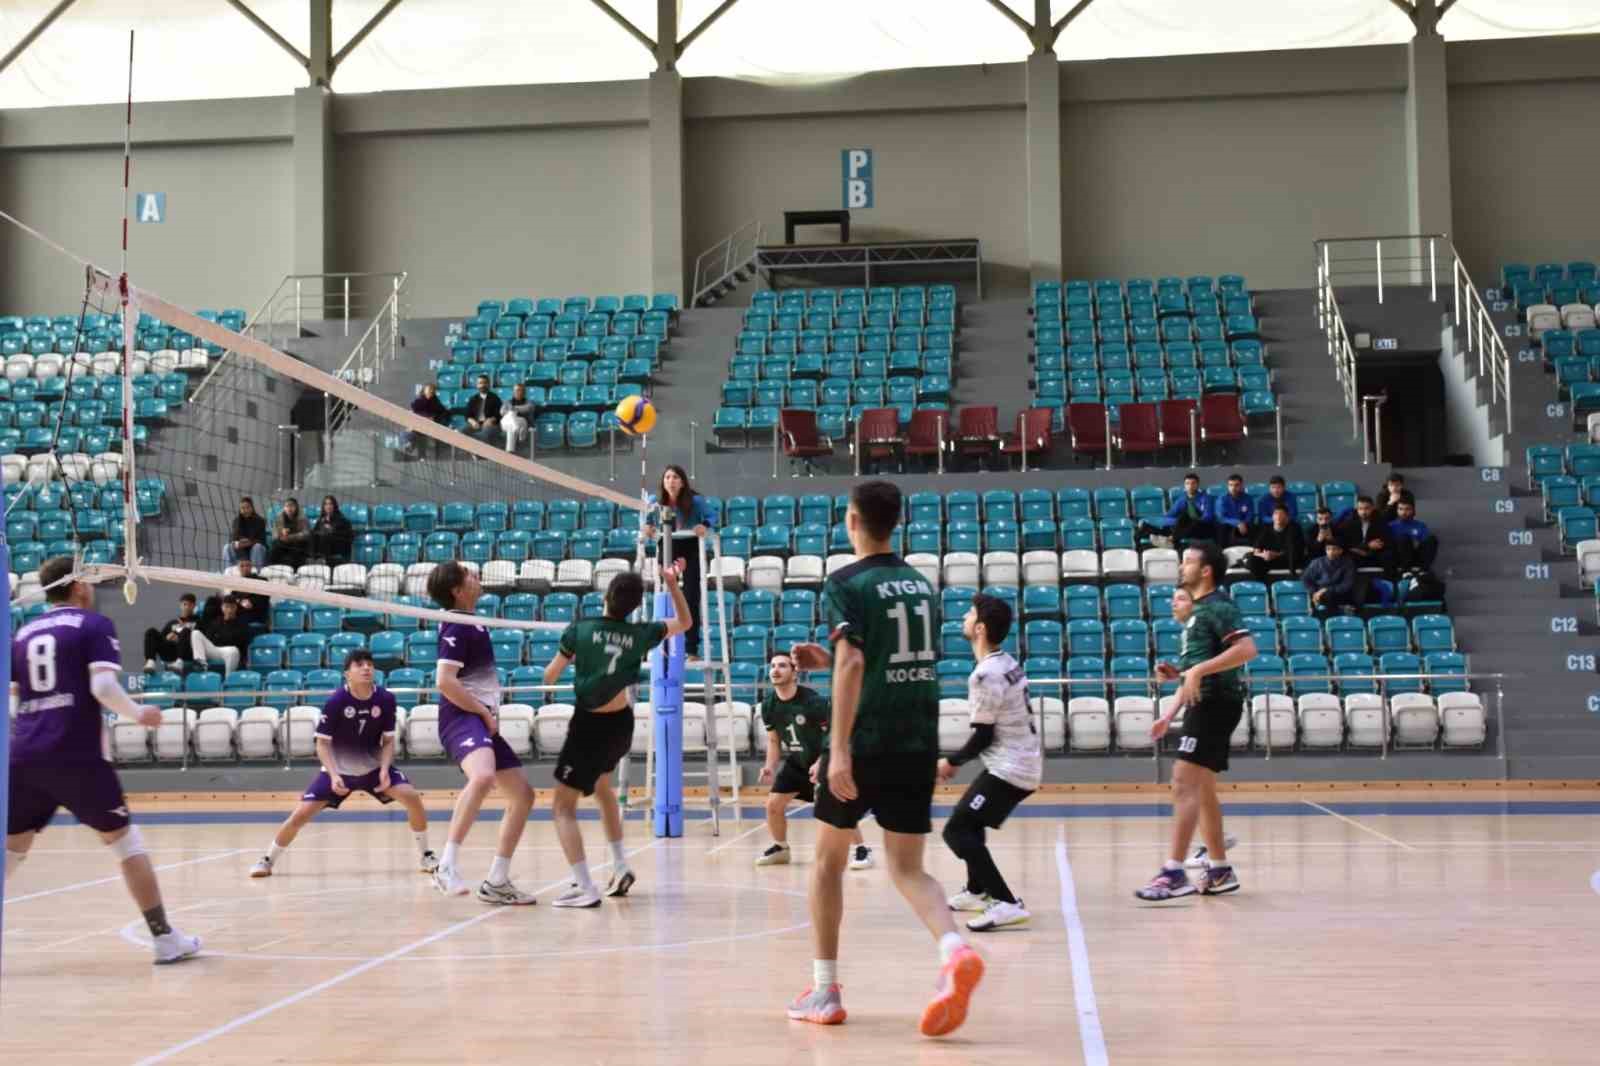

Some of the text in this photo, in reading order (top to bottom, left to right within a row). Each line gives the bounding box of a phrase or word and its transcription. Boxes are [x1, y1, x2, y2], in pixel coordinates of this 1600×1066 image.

[849, 150, 867, 178] P
[848, 180, 867, 208] B
[141, 194, 160, 222] A
[1518, 350, 1535, 362] C4
[1546, 404, 1564, 417] C6
[1481, 468, 1500, 482] C8
[1495, 500, 1513, 513] C9
[1508, 531, 1533, 545] C10
[1525, 564, 1549, 579] C11
[886, 599, 936, 663] 11
[1551, 617, 1577, 632] C12
[27, 633, 56, 692] 8
[604, 644, 622, 675] 7
[1567, 654, 1595, 670] C13
[785, 724, 800, 745] 1
[1178, 736, 1197, 752] 10
